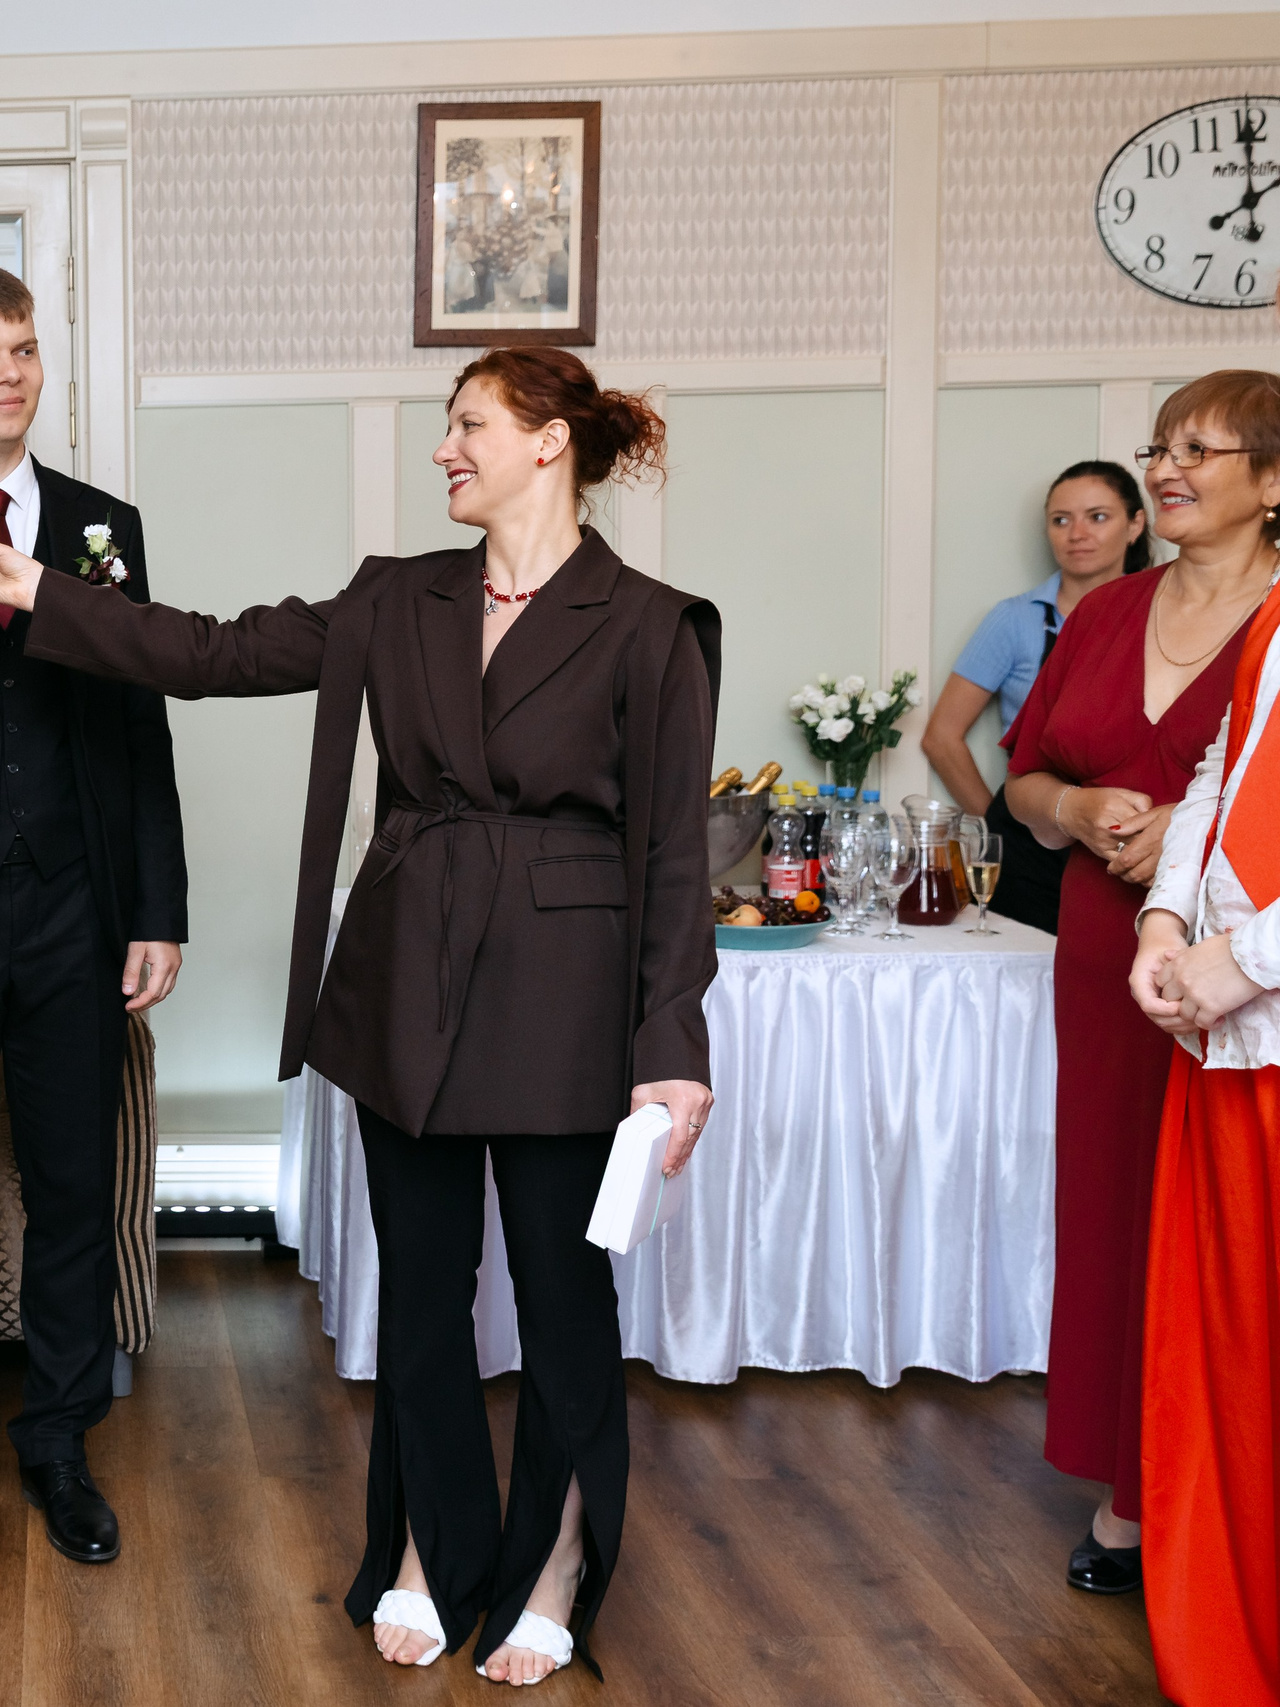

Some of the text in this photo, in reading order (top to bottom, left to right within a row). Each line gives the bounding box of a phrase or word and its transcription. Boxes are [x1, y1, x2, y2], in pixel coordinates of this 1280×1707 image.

[1189, 117, 1222, 153] 11
[1233, 107, 1267, 143] 12
[1143, 140, 1180, 179] 10
[1113, 185, 1136, 226] 9
[1143, 234, 1166, 273] 8
[1192, 253, 1214, 291] 7
[1234, 257, 1258, 297] 6
